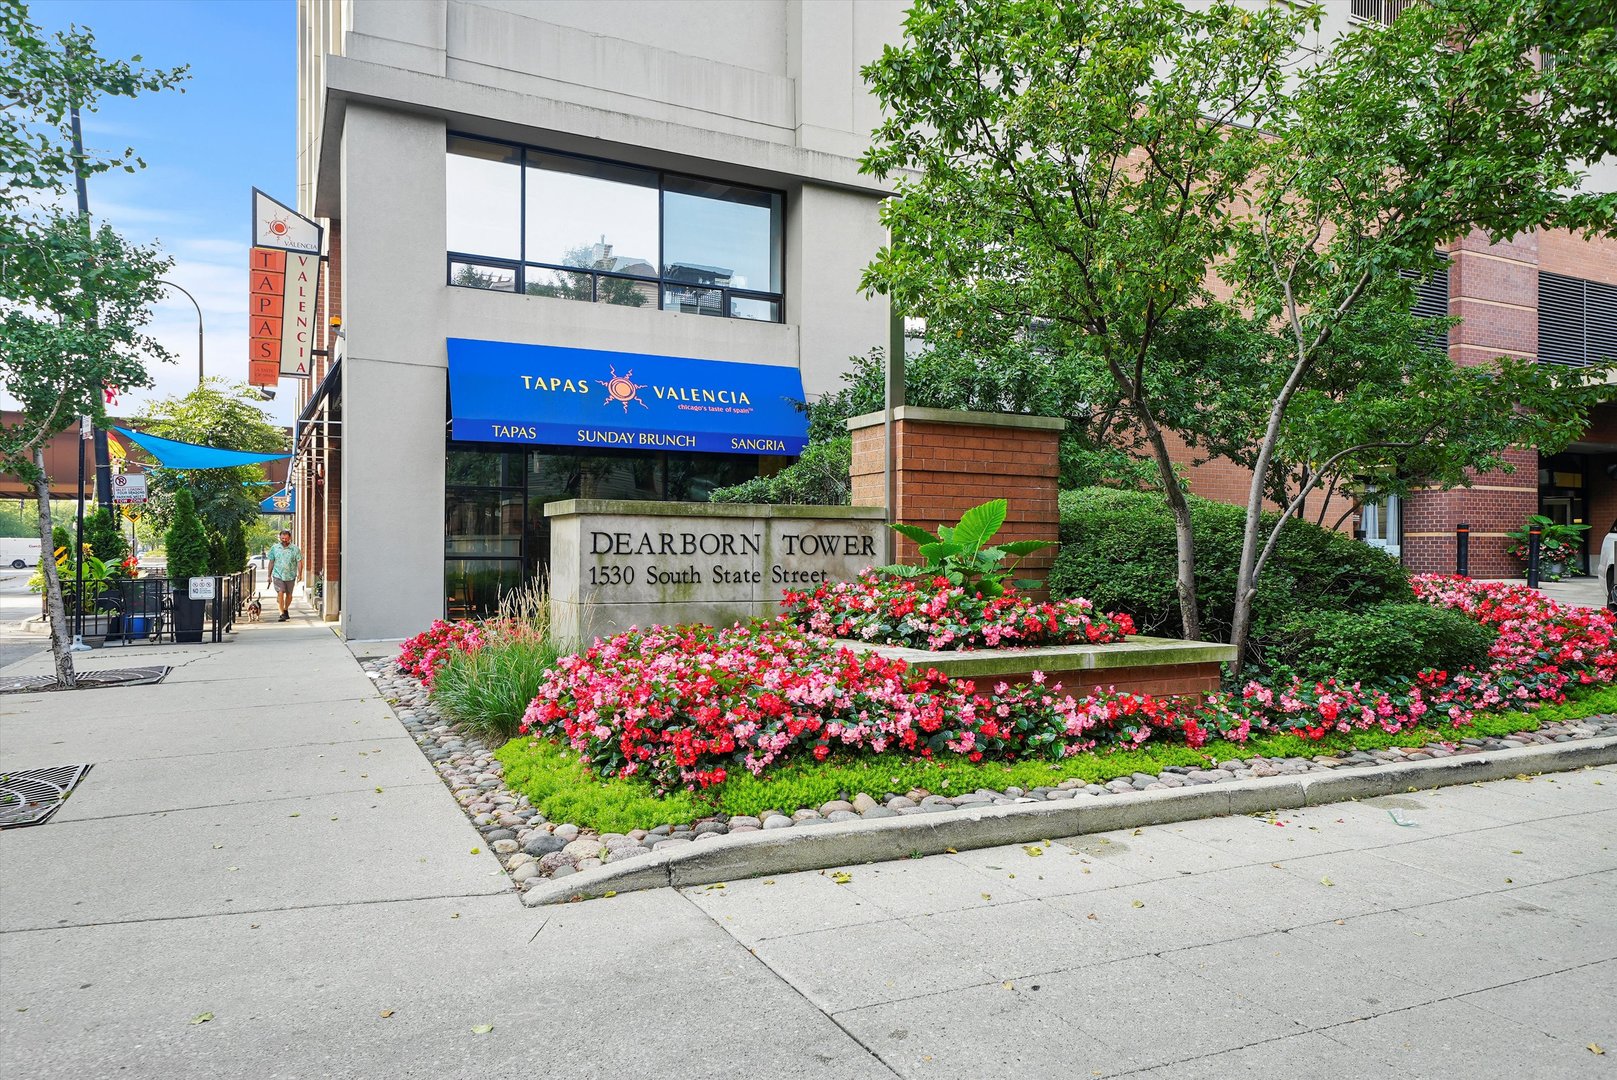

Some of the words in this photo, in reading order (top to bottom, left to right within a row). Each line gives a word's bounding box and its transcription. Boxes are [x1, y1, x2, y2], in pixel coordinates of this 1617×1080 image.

[284, 240, 318, 250] VALENCIA
[258, 252, 273, 358] TAPAS
[296, 256, 307, 373] VALENCIA
[521, 375, 589, 394] TAPAS
[653, 384, 751, 405] VALENCIA
[678, 404, 707, 412] chicago's
[492, 424, 537, 440] TAPAS
[577, 430, 637, 445] SUNDAY
[639, 432, 696, 447] BRUNCH
[731, 437, 786, 451] SANGRIA
[589, 531, 761, 555] DEARBORN
[781, 534, 877, 556] TOWER
[589, 565, 635, 585] 1530
[646, 565, 702, 585] South
[712, 565, 761, 584] State
[771, 565, 828, 584] Street
